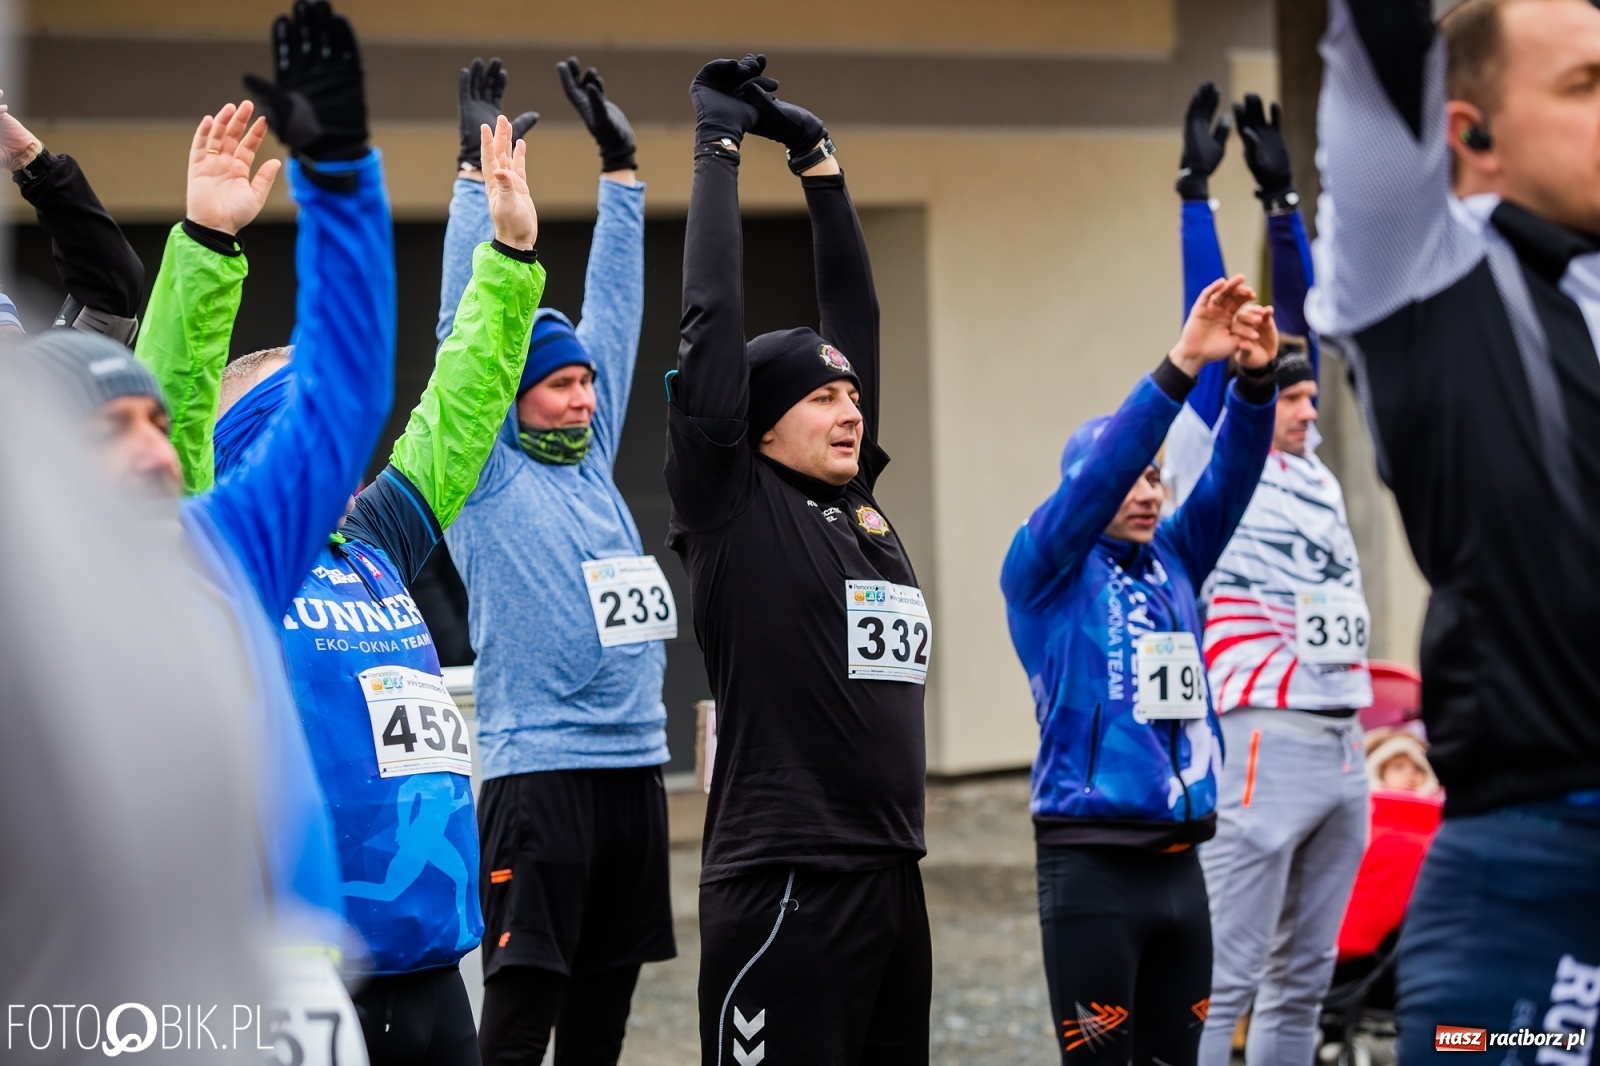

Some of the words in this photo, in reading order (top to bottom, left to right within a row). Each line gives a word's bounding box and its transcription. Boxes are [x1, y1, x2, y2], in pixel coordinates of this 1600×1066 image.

[600, 586, 669, 628] 233
[401, 633, 431, 650] TEAM
[857, 616, 928, 665] 332
[1307, 615, 1366, 648] 338
[1107, 649, 1124, 701] TEAM
[382, 705, 468, 755] 452
